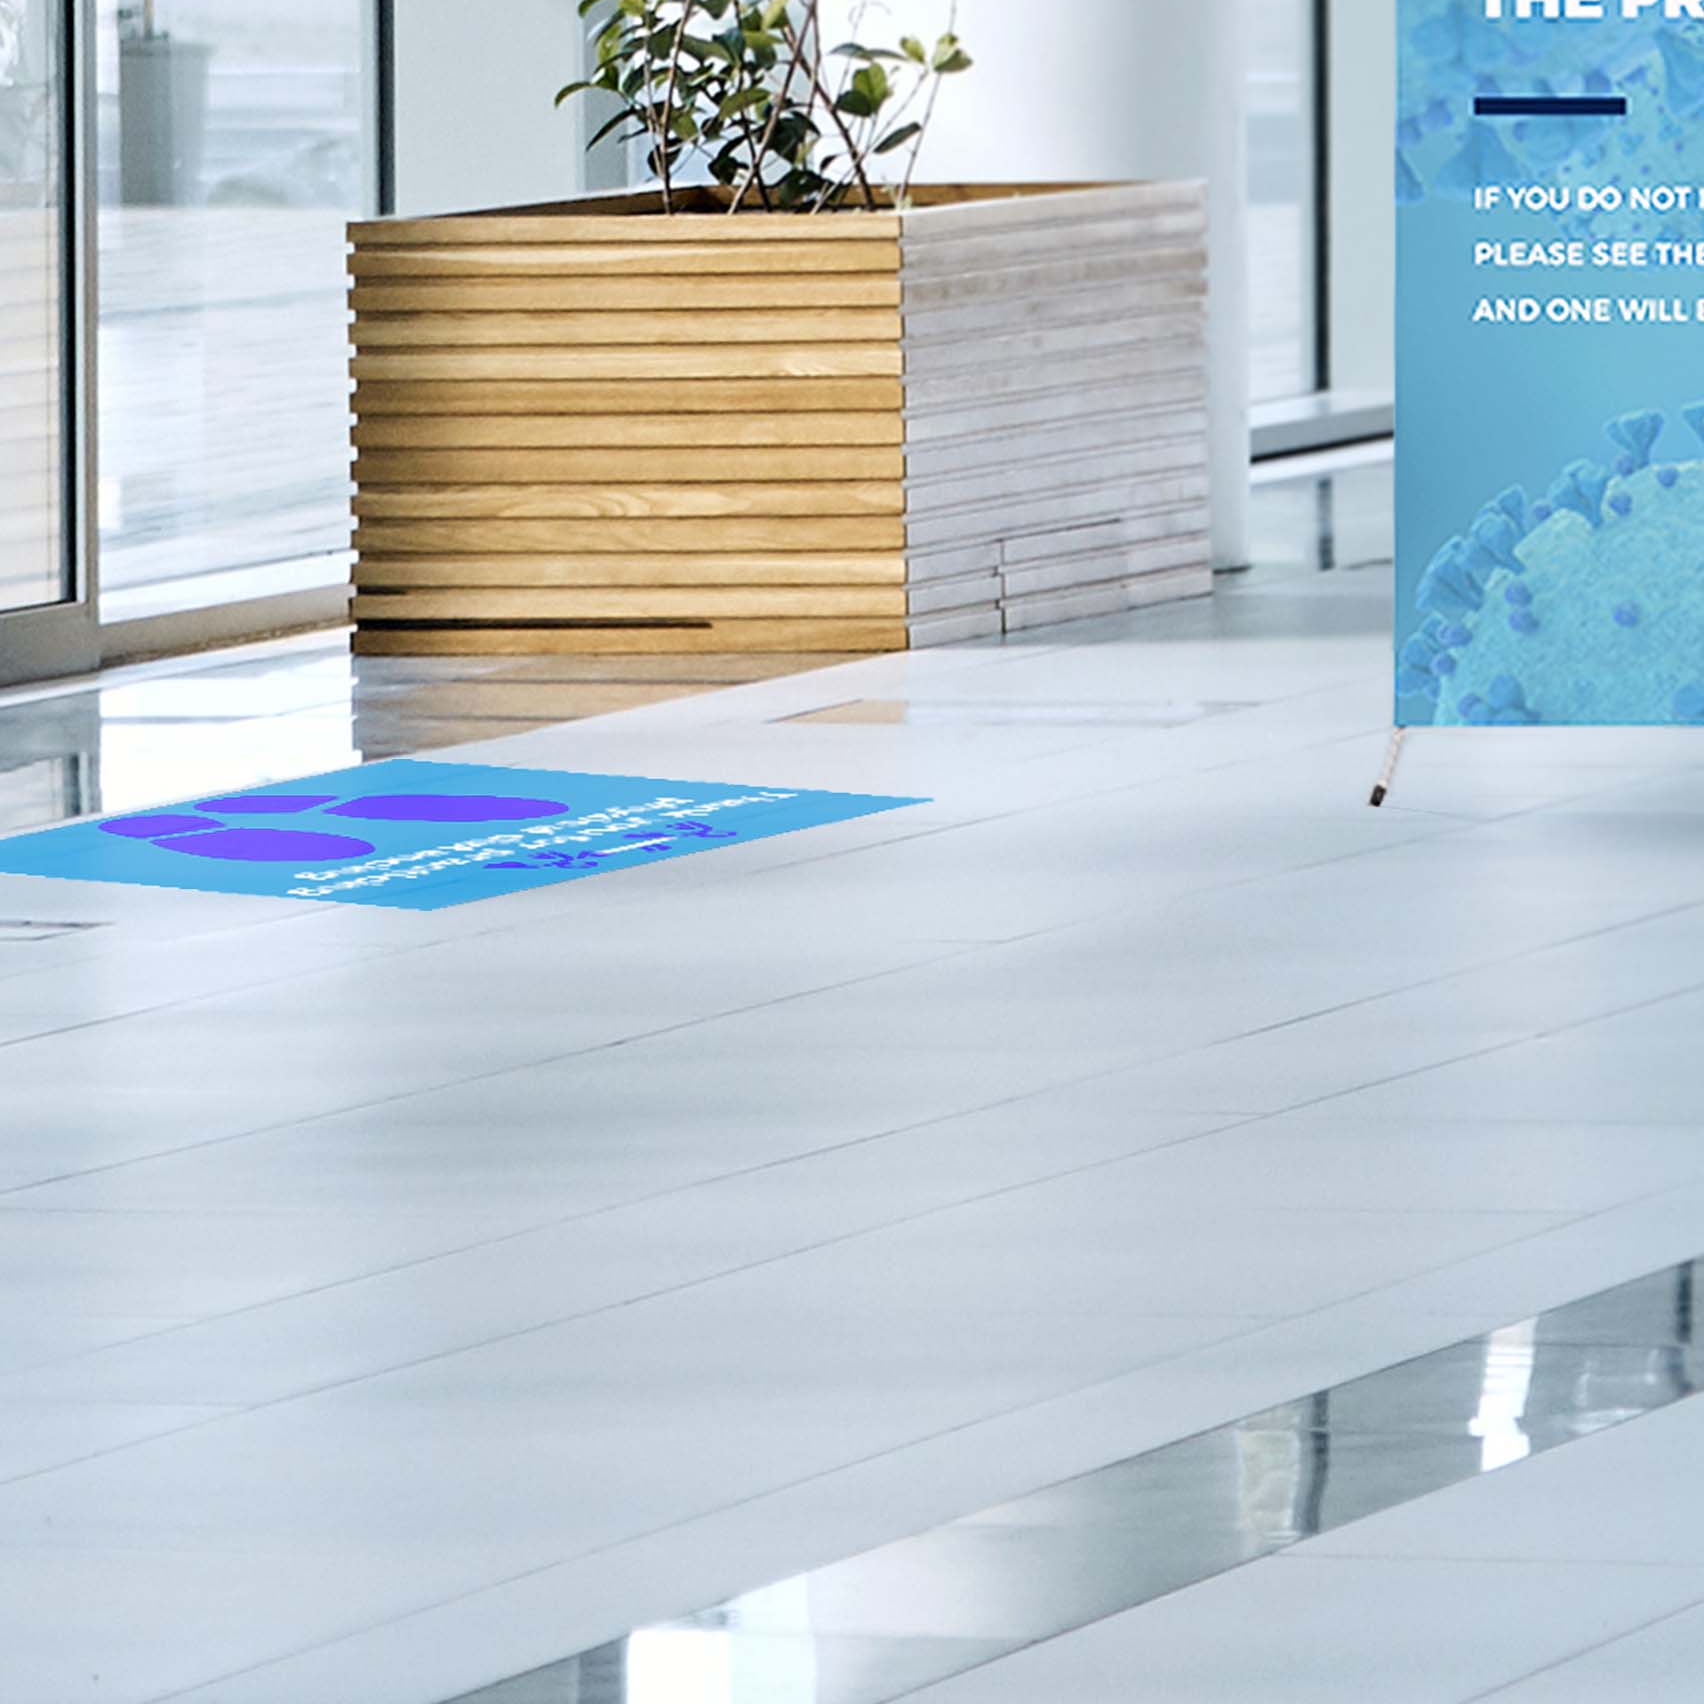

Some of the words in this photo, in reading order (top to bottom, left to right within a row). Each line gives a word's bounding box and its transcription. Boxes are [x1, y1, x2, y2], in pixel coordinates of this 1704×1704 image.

[1474, 186, 1500, 211] IF
[1507, 186, 1570, 211] YOU
[1577, 186, 1622, 211] DO
[1630, 186, 1691, 211] NOT
[1474, 242, 1584, 267] PLEASE
[1592, 242, 1647, 267] SEE
[1472, 298, 1541, 323] AND
[1546, 298, 1611, 323] ONE
[1618, 298, 1688, 323] WILL
